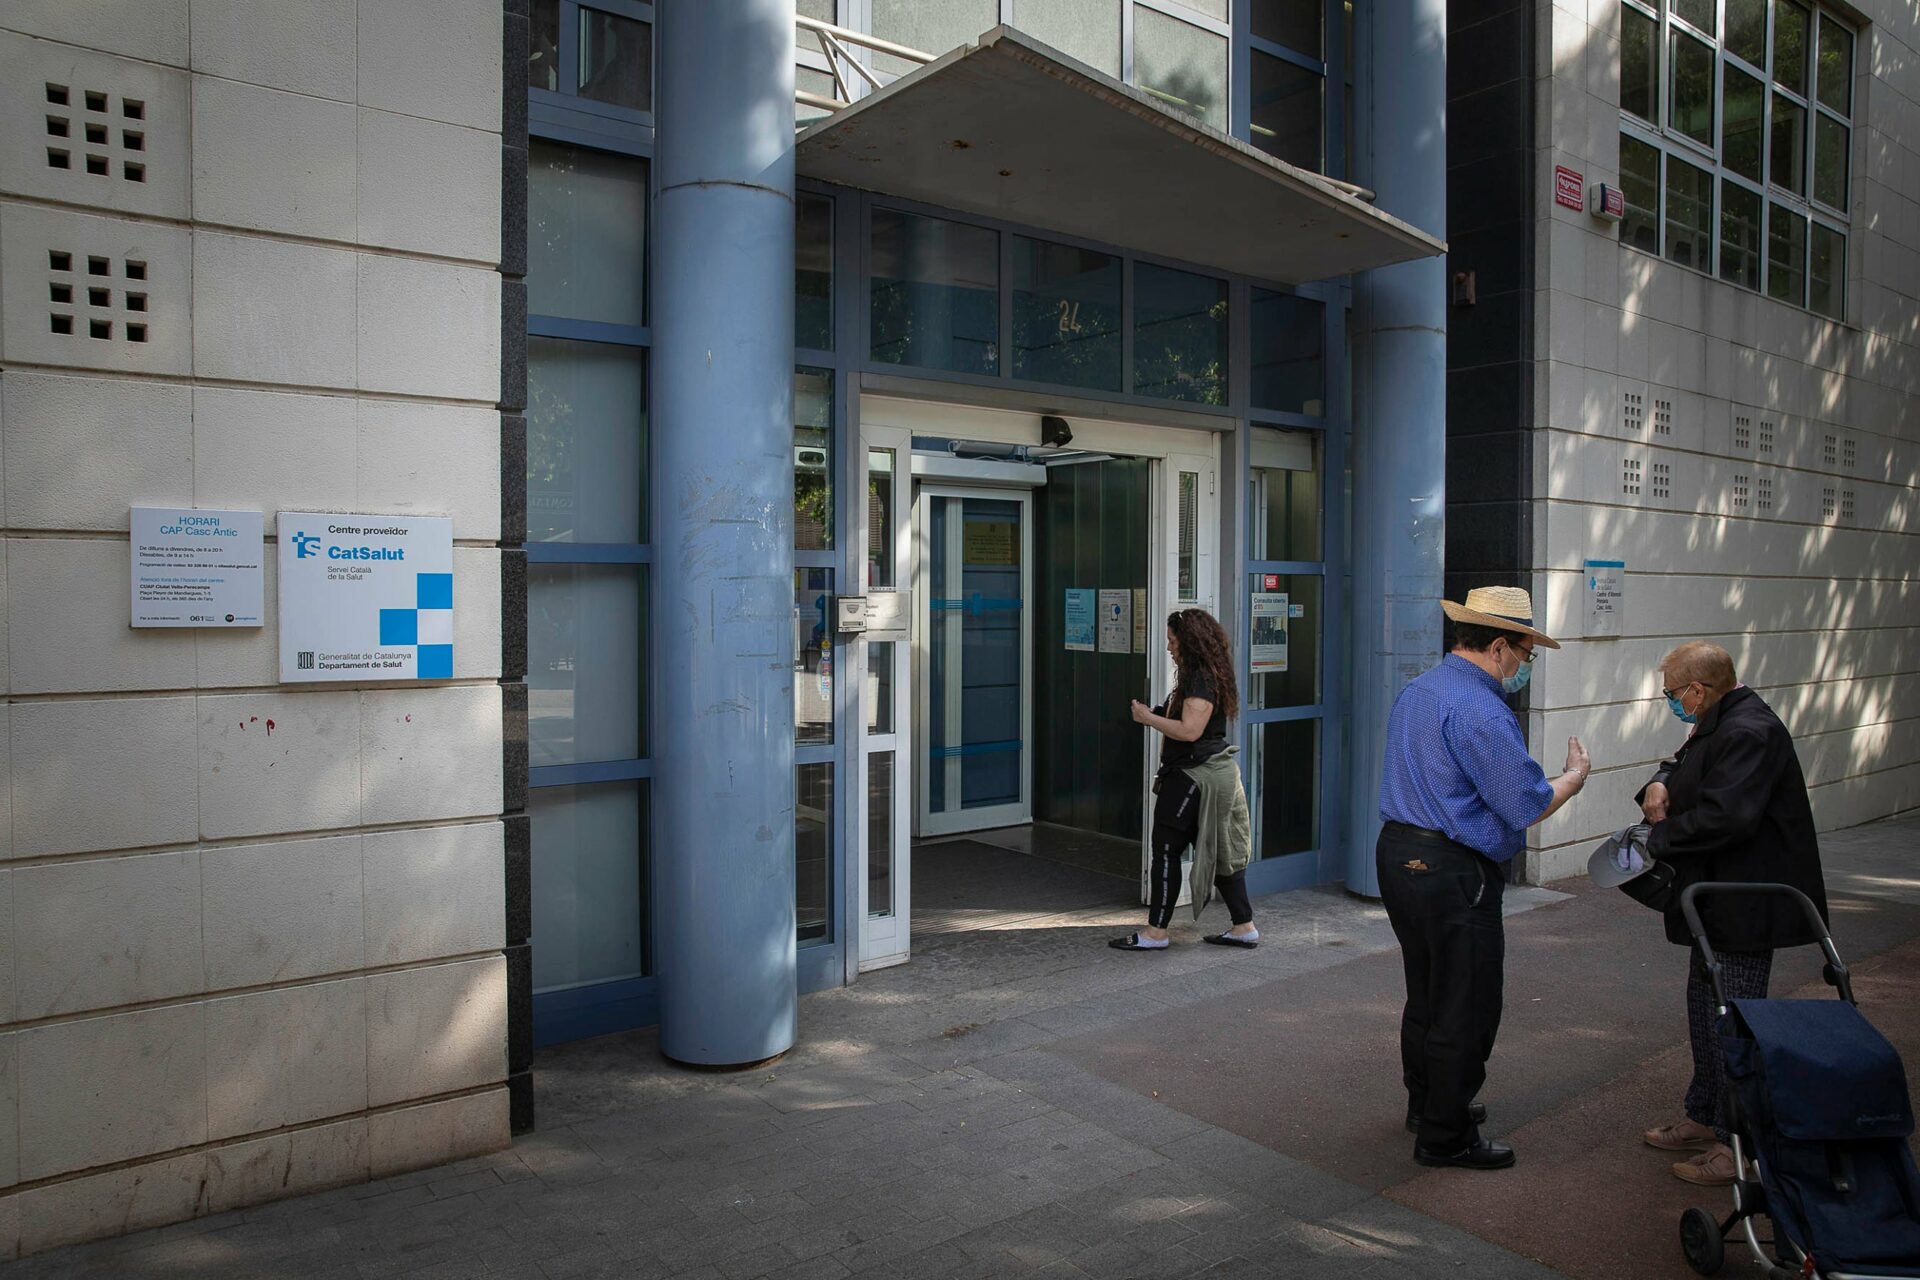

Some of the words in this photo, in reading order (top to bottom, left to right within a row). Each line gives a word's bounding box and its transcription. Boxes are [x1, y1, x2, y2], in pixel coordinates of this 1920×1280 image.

[1059, 300, 1082, 334] 24
[179, 516, 220, 526] HORARI
[160, 526, 182, 535] CAP
[185, 526, 211, 536] Casc
[213, 528, 238, 537] Antic
[328, 524, 361, 535] Centre
[363, 526, 408, 536] proveïdor
[328, 546, 404, 560] CatSalut
[318, 653, 361, 661] Generalitat
[374, 652, 412, 661] Catalunya
